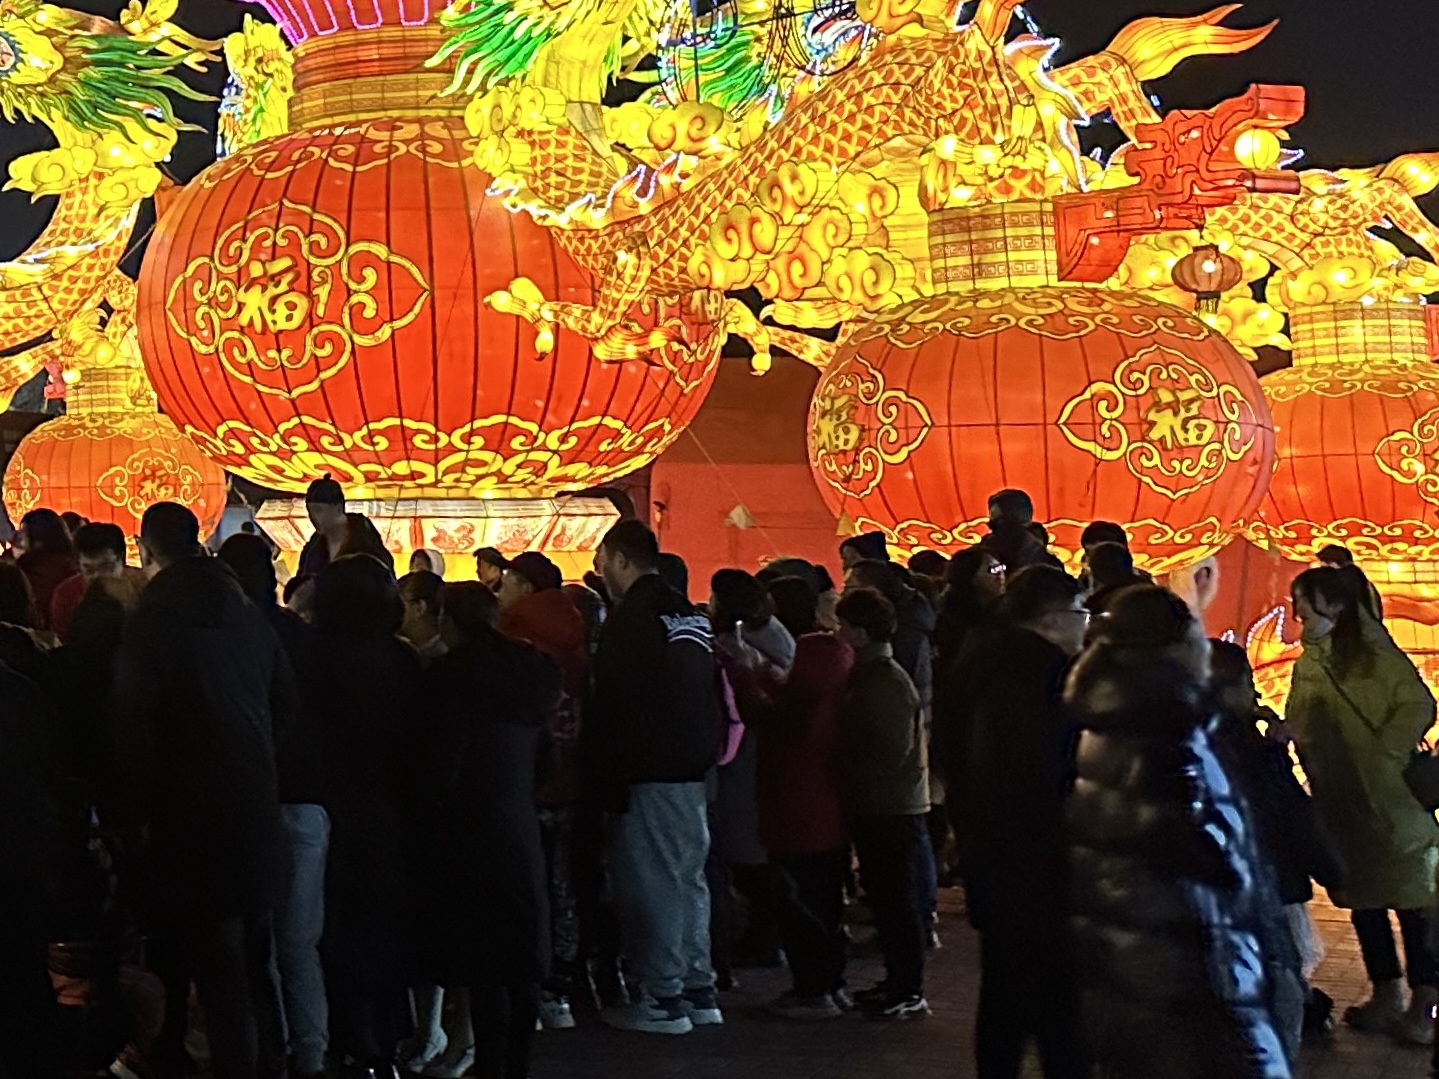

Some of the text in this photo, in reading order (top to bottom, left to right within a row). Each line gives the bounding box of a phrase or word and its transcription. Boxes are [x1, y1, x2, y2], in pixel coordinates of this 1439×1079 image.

[236, 256, 311, 334] 福
[817, 394, 860, 453] 福
[1145, 386, 1217, 450] 福
[139, 468, 175, 501] 福
